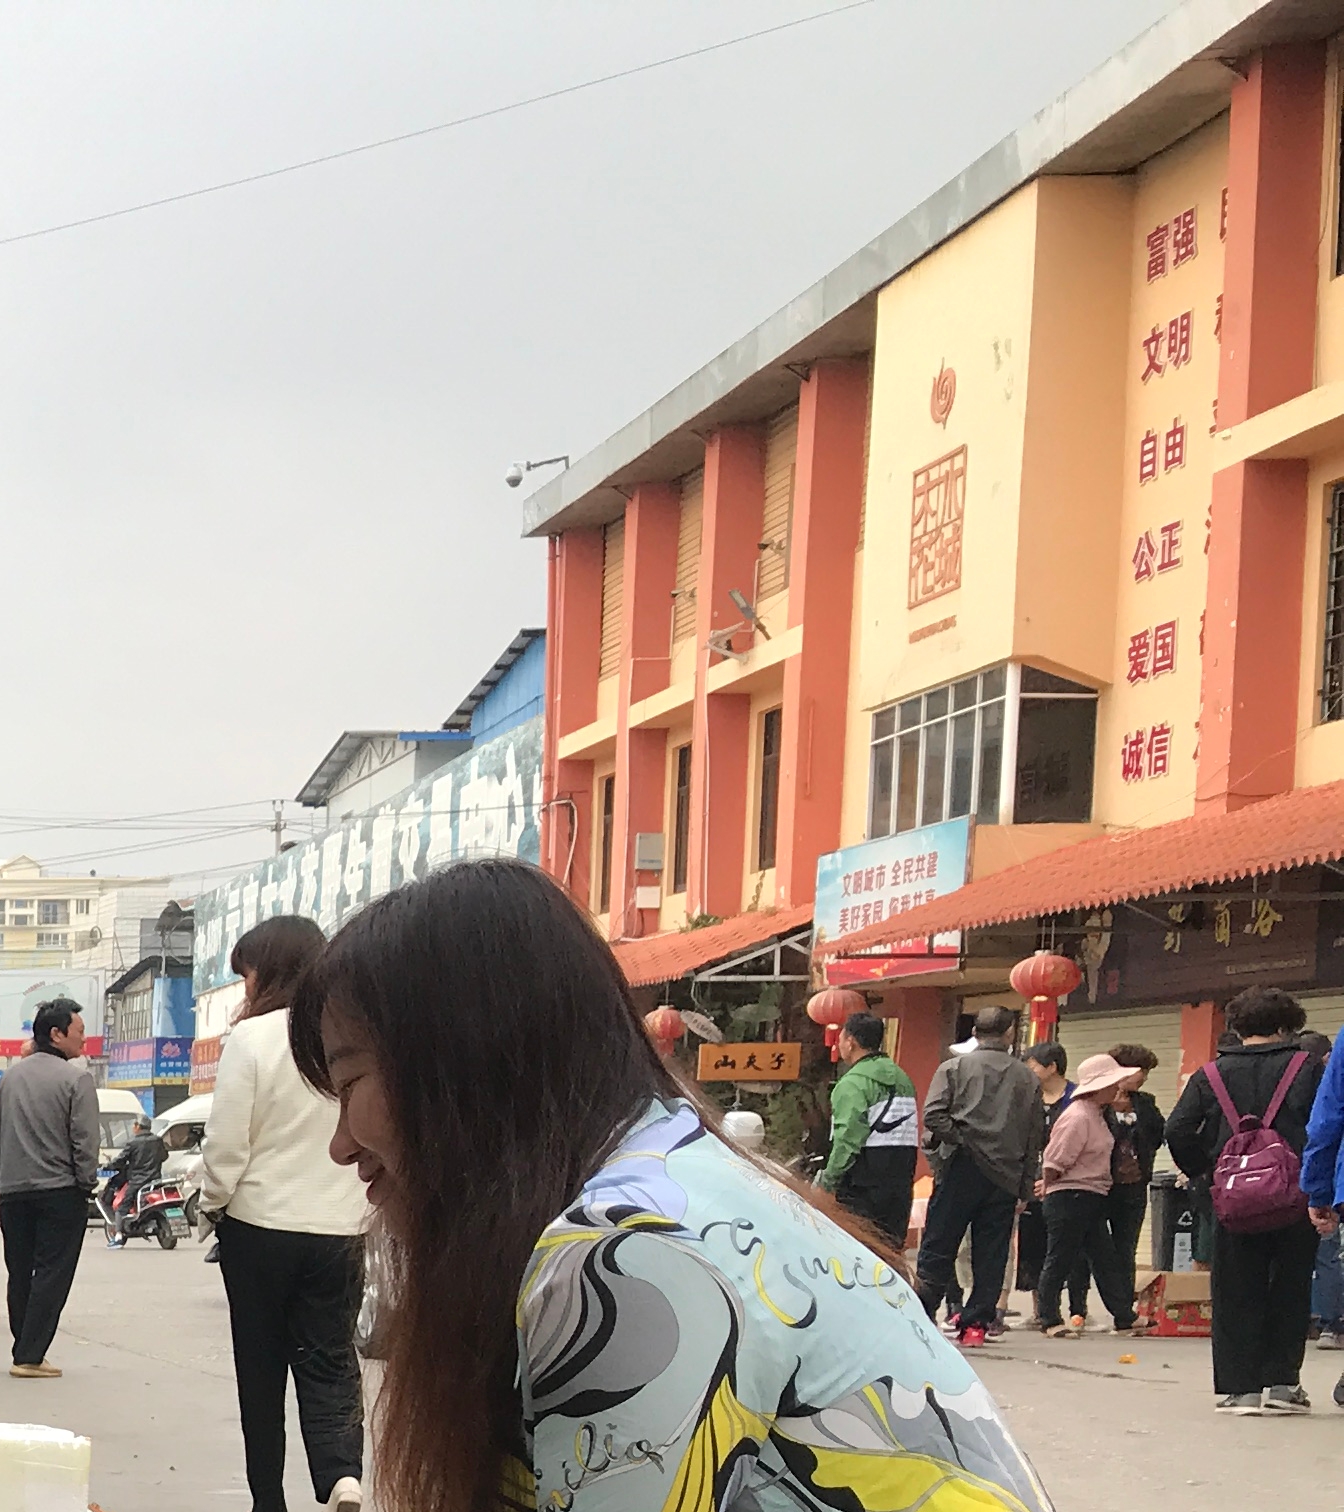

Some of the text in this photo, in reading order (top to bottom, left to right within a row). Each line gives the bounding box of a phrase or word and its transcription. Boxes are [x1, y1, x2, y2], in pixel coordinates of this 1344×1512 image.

[1146, 207, 1196, 282] 富强
[1141, 309, 1192, 383] 文明
[1139, 416, 1185, 484] 自由
[1132, 520, 1181, 582] 公正
[1127, 620, 1176, 683] 爱国
[1121, 722, 1171, 782] 诚信
[841, 851, 938, 898] 文明城市 全民共建
[838, 900, 884, 934] 美好家园
